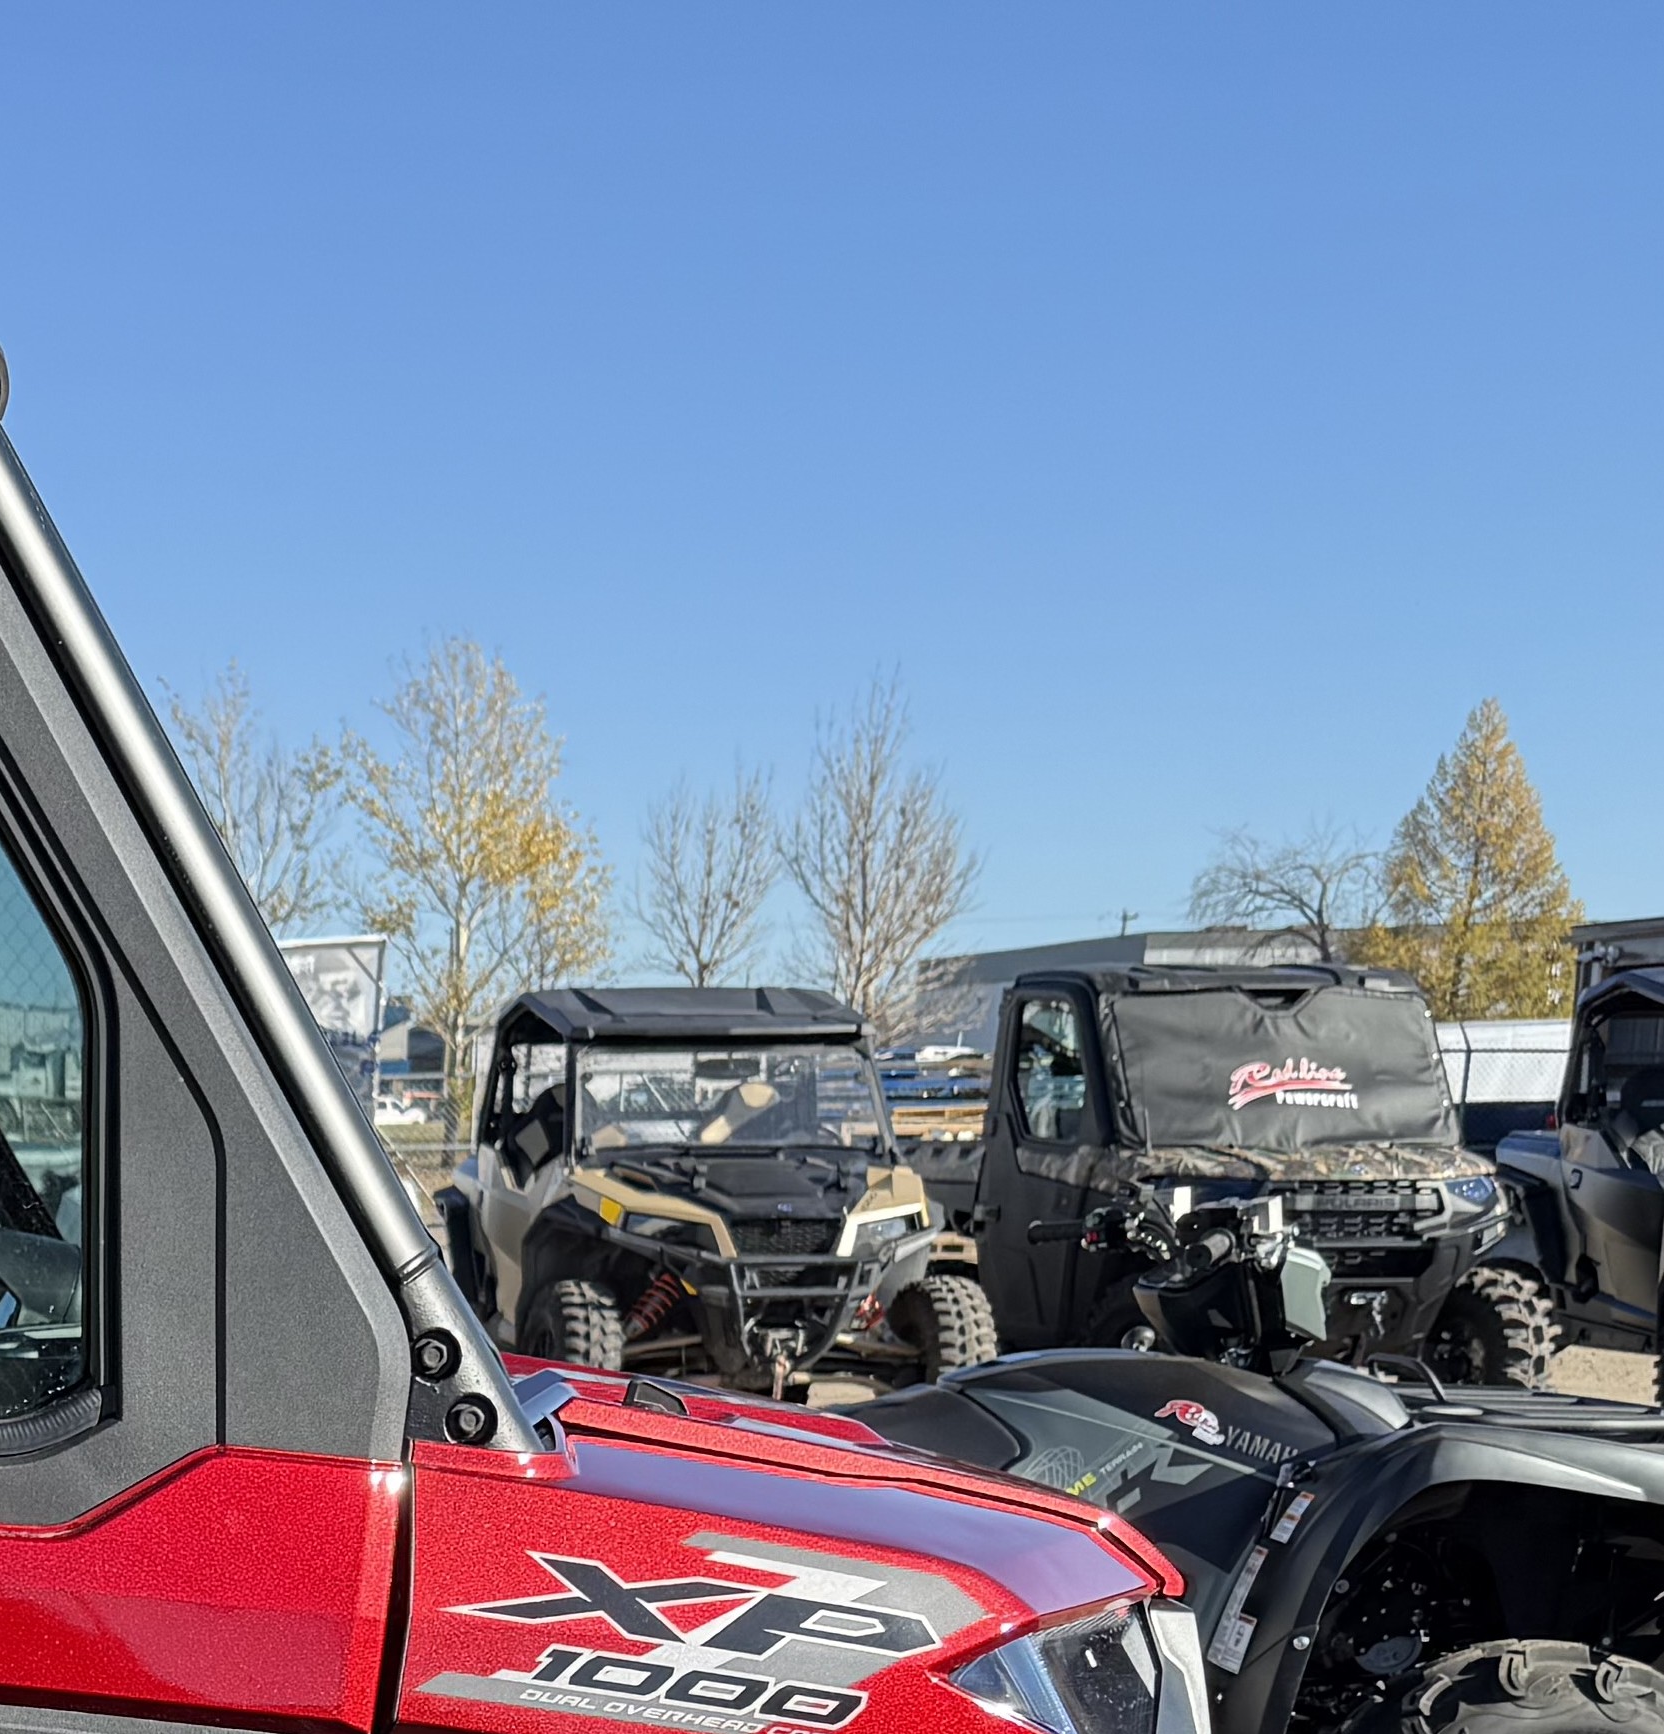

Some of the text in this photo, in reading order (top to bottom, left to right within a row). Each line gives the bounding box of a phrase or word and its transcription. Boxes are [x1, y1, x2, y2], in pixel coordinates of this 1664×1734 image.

[1223, 1425, 1299, 1464] YAMAH
[439, 1549, 944, 1658] XP
[520, 1688, 598, 1712] DUAL
[603, 1700, 767, 1734] OVERHEAD
[531, 1642, 870, 1731] 1000
